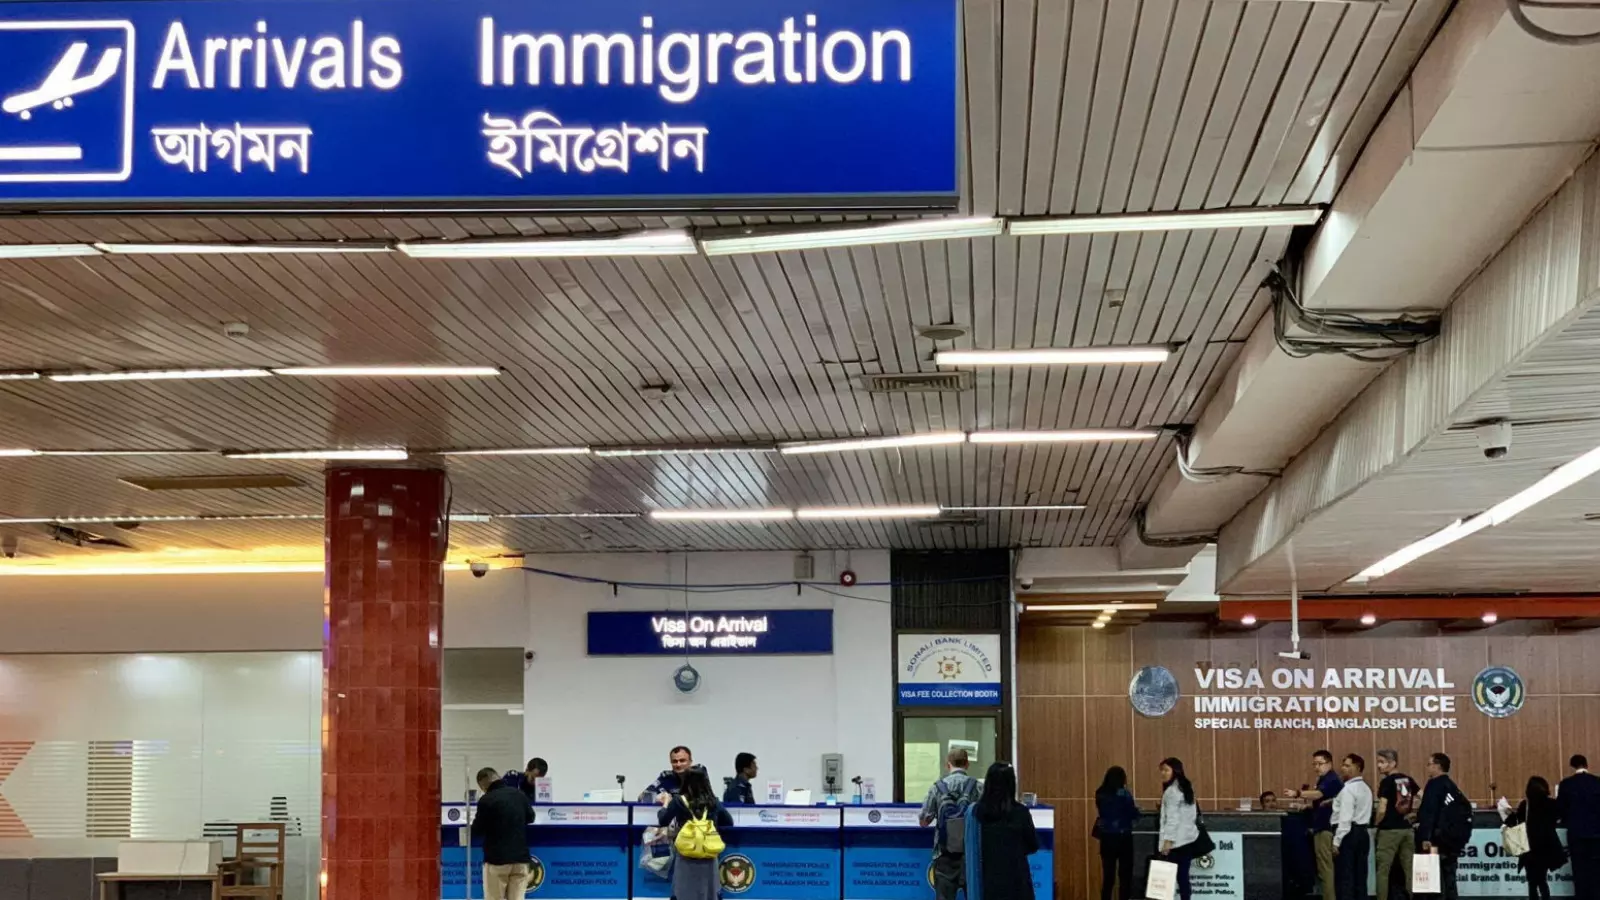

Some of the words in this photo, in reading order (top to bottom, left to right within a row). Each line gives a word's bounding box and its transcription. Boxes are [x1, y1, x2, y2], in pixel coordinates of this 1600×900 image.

[152, 20, 403, 89] Arrivals
[479, 14, 912, 102] Immigration
[151, 124, 311, 174] আগমন
[482, 111, 708, 178] ইমিগ্রেশন
[652, 616, 686, 633] Visa
[690, 616, 714, 633] On
[717, 616, 768, 633] Arrival
[907, 642, 933, 672] SONALI
[935, 637, 962, 646] BANK
[963, 641, 992, 672] LIMITED
[1194, 668, 1264, 689] VISA
[1271, 668, 1314, 689] ON
[1321, 668, 1455, 689] ARRIVAL
[901, 690, 916, 698] VISA
[917, 690, 930, 698] FEE
[931, 690, 973, 698] COLLECTION
[974, 690, 998, 698] BOOTH
[1194, 696, 1359, 712] IMMIGRATION
[1365, 696, 1455, 712] POLICE
[1194, 718, 1250, 729] SPECIAL
[1254, 718, 1315, 731] BRANCH,
[1317, 718, 1406, 729] BANGLADESH
[1410, 718, 1457, 729] POLICE
[1219, 840, 1234, 850] Desk
[1459, 861, 1518, 871] mmigratio
[1471, 873, 1500, 882] Branch
